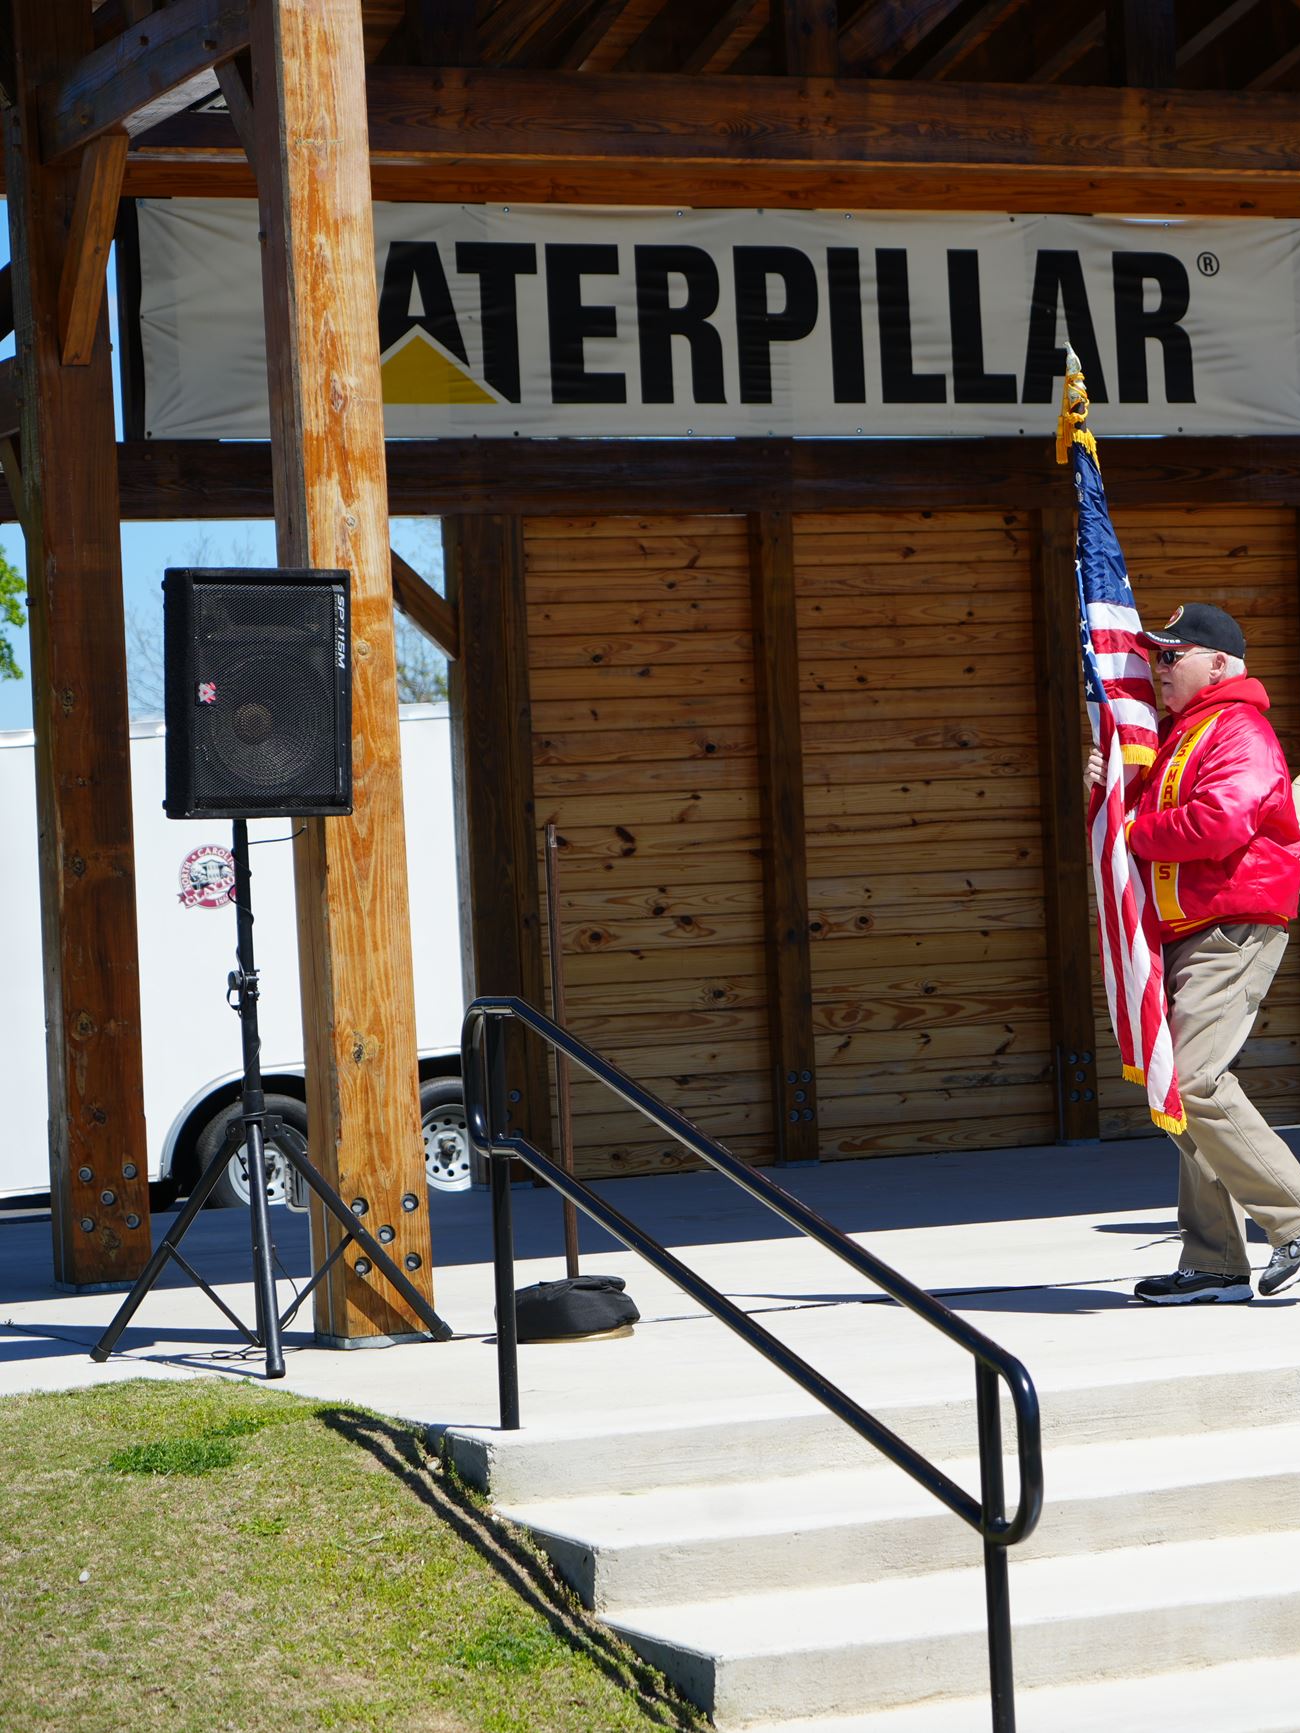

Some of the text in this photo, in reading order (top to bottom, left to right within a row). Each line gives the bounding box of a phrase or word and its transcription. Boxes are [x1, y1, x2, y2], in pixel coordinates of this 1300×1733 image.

[181, 846, 234, 892] NORTH CAROLI
[184, 876, 236, 906] CLAYTO
